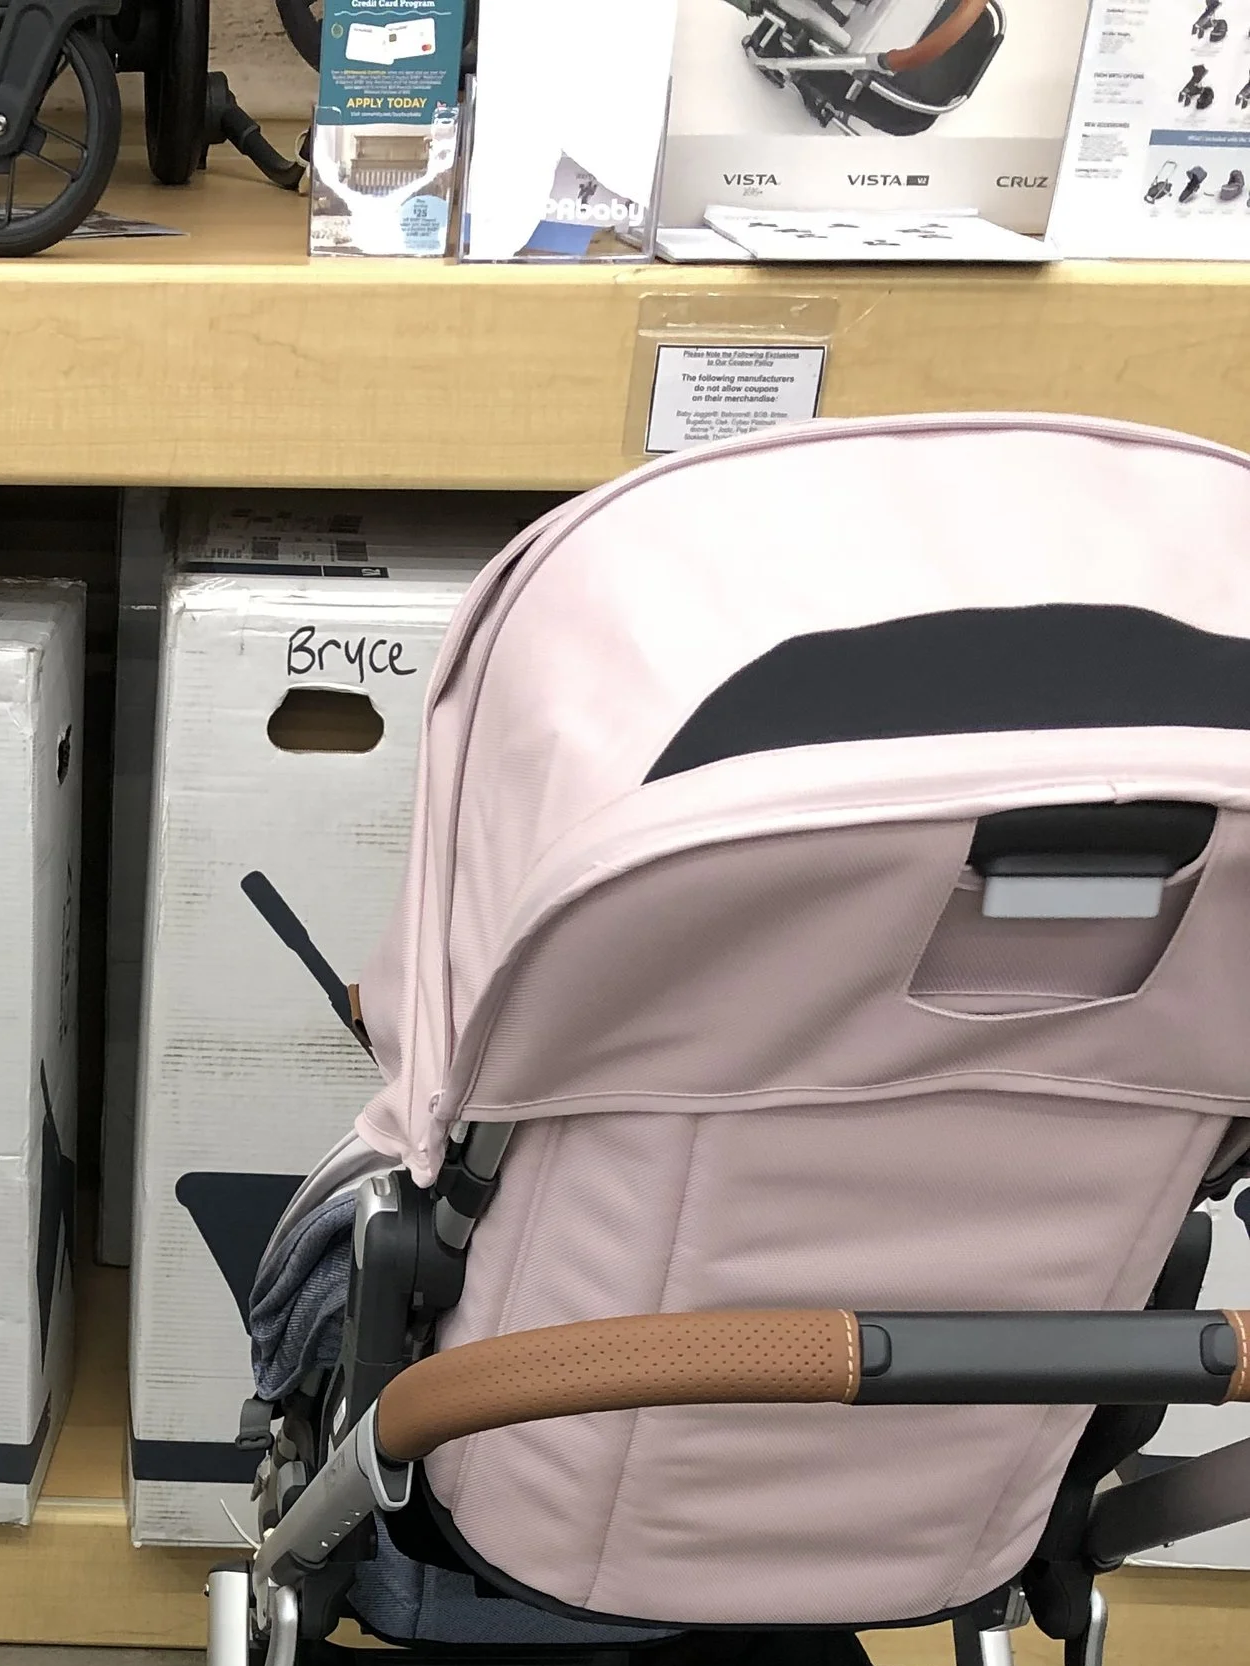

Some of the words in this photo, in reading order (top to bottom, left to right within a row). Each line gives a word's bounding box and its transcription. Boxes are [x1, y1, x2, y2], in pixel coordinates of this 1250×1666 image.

[351, 0, 378, 8] Credit
[379, 0, 398, 8] Card
[399, 0, 435, 10] Program
[346, 97, 384, 109] APPLY
[386, 97, 428, 109] TODAY
[723, 173, 778, 186] VISTA
[847, 174, 902, 186] VISTA
[996, 175, 1049, 188] CRUZ
[683, 350, 705, 360] Please
[706, 350, 721, 359] Note
[722, 351, 732, 359] the
[733, 351, 764, 360] Following
[765, 351, 800, 360] Exclusions
[728, 360, 753, 368] Coupon
[754, 360, 774, 368] Policy
[682, 374, 697, 382] The
[698, 374, 736, 384] following
[737, 375, 795, 384] manufacturers
[694, 384, 705, 393] do
[706, 385, 720, 393] not
[722, 384, 743, 393] allow
[744, 386, 779, 394] coupons
[704, 394, 723, 402] their
[287, 625, 417, 683] Bryce
